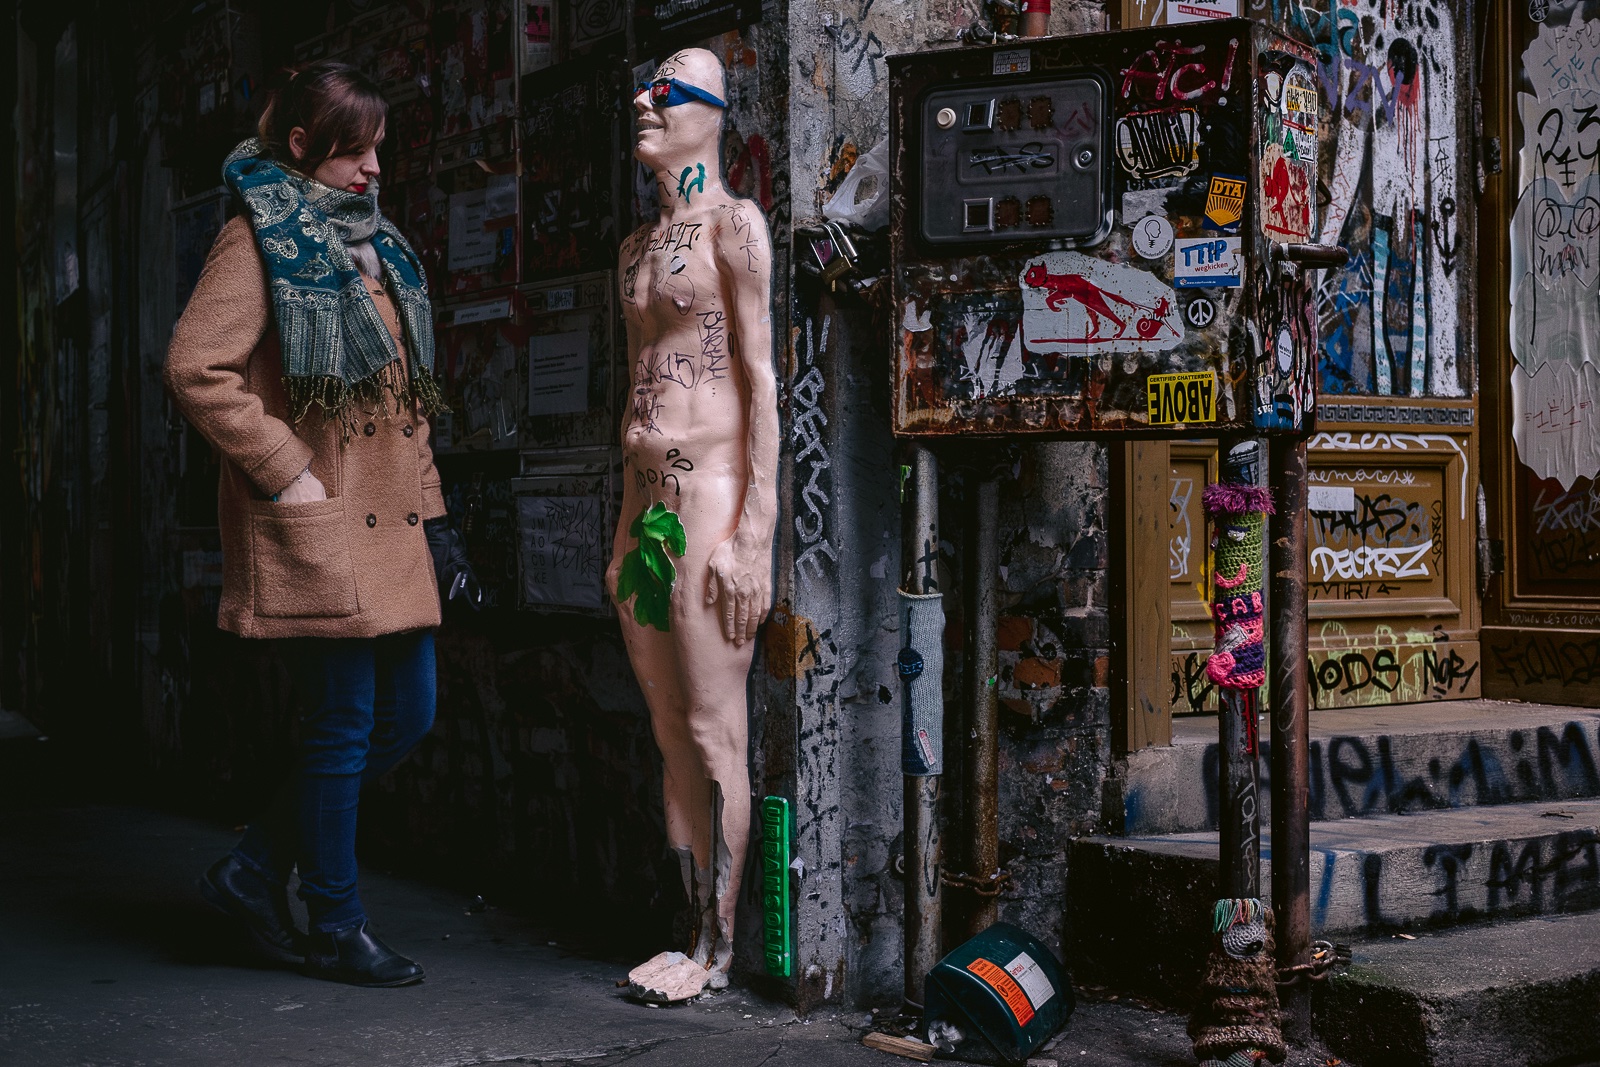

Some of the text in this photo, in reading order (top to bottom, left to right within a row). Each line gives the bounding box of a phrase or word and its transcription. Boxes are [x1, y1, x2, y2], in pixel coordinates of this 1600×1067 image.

[1193, 7, 1208, 16] FRANK
[1212, 180, 1242, 198] DTA
[1180, 240, 1228, 267] TTIP
[1194, 262, 1229, 273] wegkicken
[1149, 373, 1212, 383] CERTIFIED CHATTERBOX
[1150, 379, 1213, 424] ABOVE
[765, 805, 781, 969] URBANSOLID
